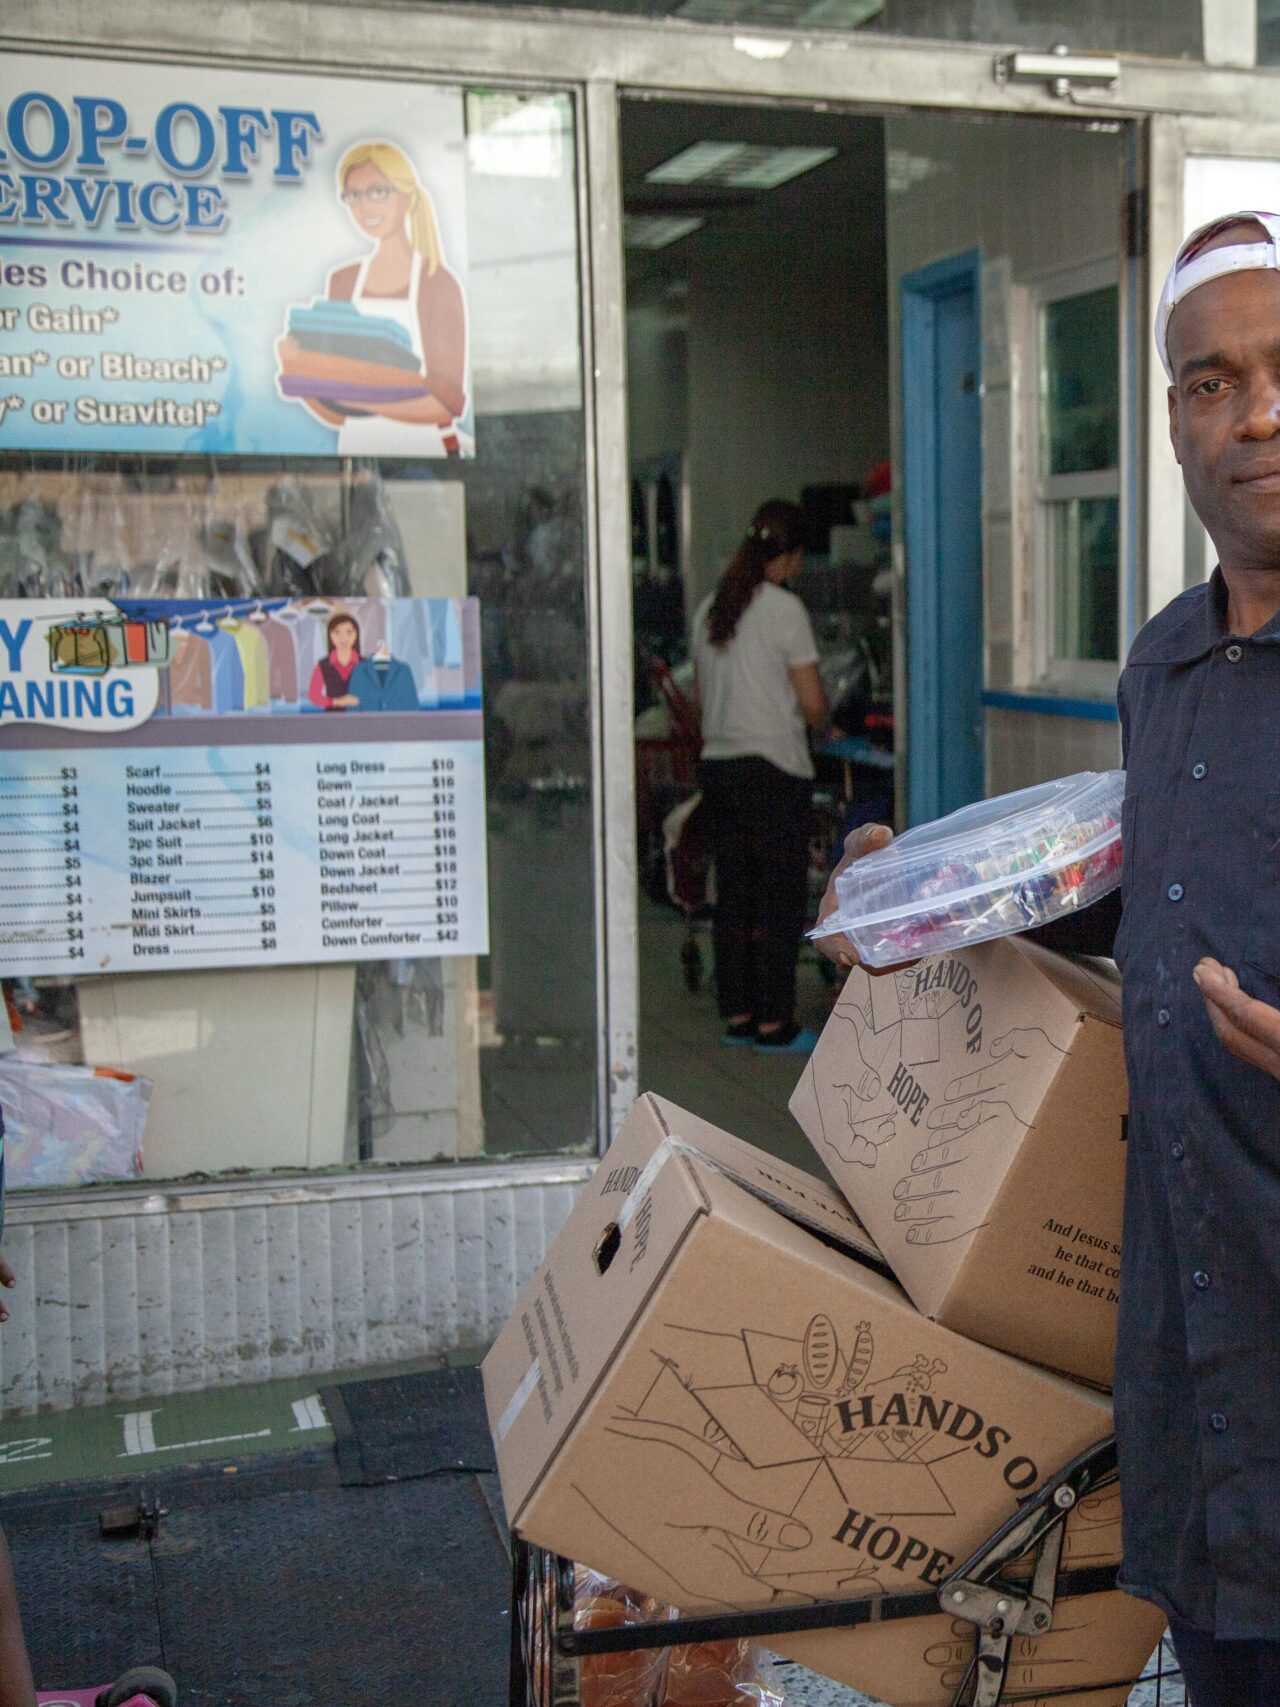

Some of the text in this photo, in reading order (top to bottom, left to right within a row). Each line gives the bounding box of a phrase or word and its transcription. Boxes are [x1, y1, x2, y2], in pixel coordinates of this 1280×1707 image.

[0, 90, 322, 177] OP-OFF
[0, 260, 244, 295] es Choice of:
[58, 356, 92, 379] or
[32, 400, 67, 424] or
[61, 766, 77, 780] $3
[126, 762, 271, 778] Scarf $4
[316, 759, 454, 775] Long Dress $10
[62, 784, 78, 798] $4
[127, 780, 271, 796] Hoodie $5
[317, 778, 352, 790] Gown
[127, 798, 272, 814] Sweater $5
[318, 796, 346, 808] Coat
[357, 795, 399, 807] Jacket
[432, 794, 455, 806] $12
[62, 803, 79, 816] $4
[128, 819, 154, 832] Suit
[158, 818, 201, 831] Jacket
[318, 813, 348, 827] Long
[352, 812, 380, 824] Coat
[63, 821, 80, 834] $4
[128, 833, 273, 851] 2pc Suit $10
[318, 830, 349, 844] Long
[352, 829, 394, 841] Jacket
[64, 839, 80, 852] $4
[319, 847, 354, 860] Down
[357, 846, 386, 859] Coat
[65, 857, 81, 870] $5
[129, 850, 274, 869] 3pc Suit $14
[320, 865, 355, 877] Down
[358, 863, 399, 875] Jacket
[65, 875, 82, 888] $4
[130, 872, 171, 884] Blazer
[320, 879, 457, 894] Bedsheet $12
[66, 893, 82, 906] $4
[131, 885, 275, 905] Jumpsuit $10
[321, 896, 458, 911] Pillow $10
[67, 911, 83, 923] $4
[131, 903, 275, 920] Mini Skirts $5
[321, 916, 382, 929] Comforter
[67, 929, 84, 941] $4
[132, 925, 161, 937] Midi
[164, 924, 195, 937] Skirt
[322, 930, 459, 946] Down Comforter $42
[68, 947, 84, 959] $4
[133, 943, 170, 955] Dress
[913, 959, 983, 1055] HANDS OF
[886, 1061, 930, 1128] HOPE
[600, 1166, 643, 1196] HAND
[1042, 1218, 1074, 1238] And
[1072, 1228, 1110, 1251] Jesus
[1054, 1246, 1073, 1262] he
[1075, 1255, 1104, 1273] that
[1027, 1264, 1056, 1280] and
[1056, 1272, 1075, 1287] he
[1076, 1279, 1105, 1298] that
[834, 1392, 1012, 1459] HANDS
[832, 1508, 955, 1588] HOPE
